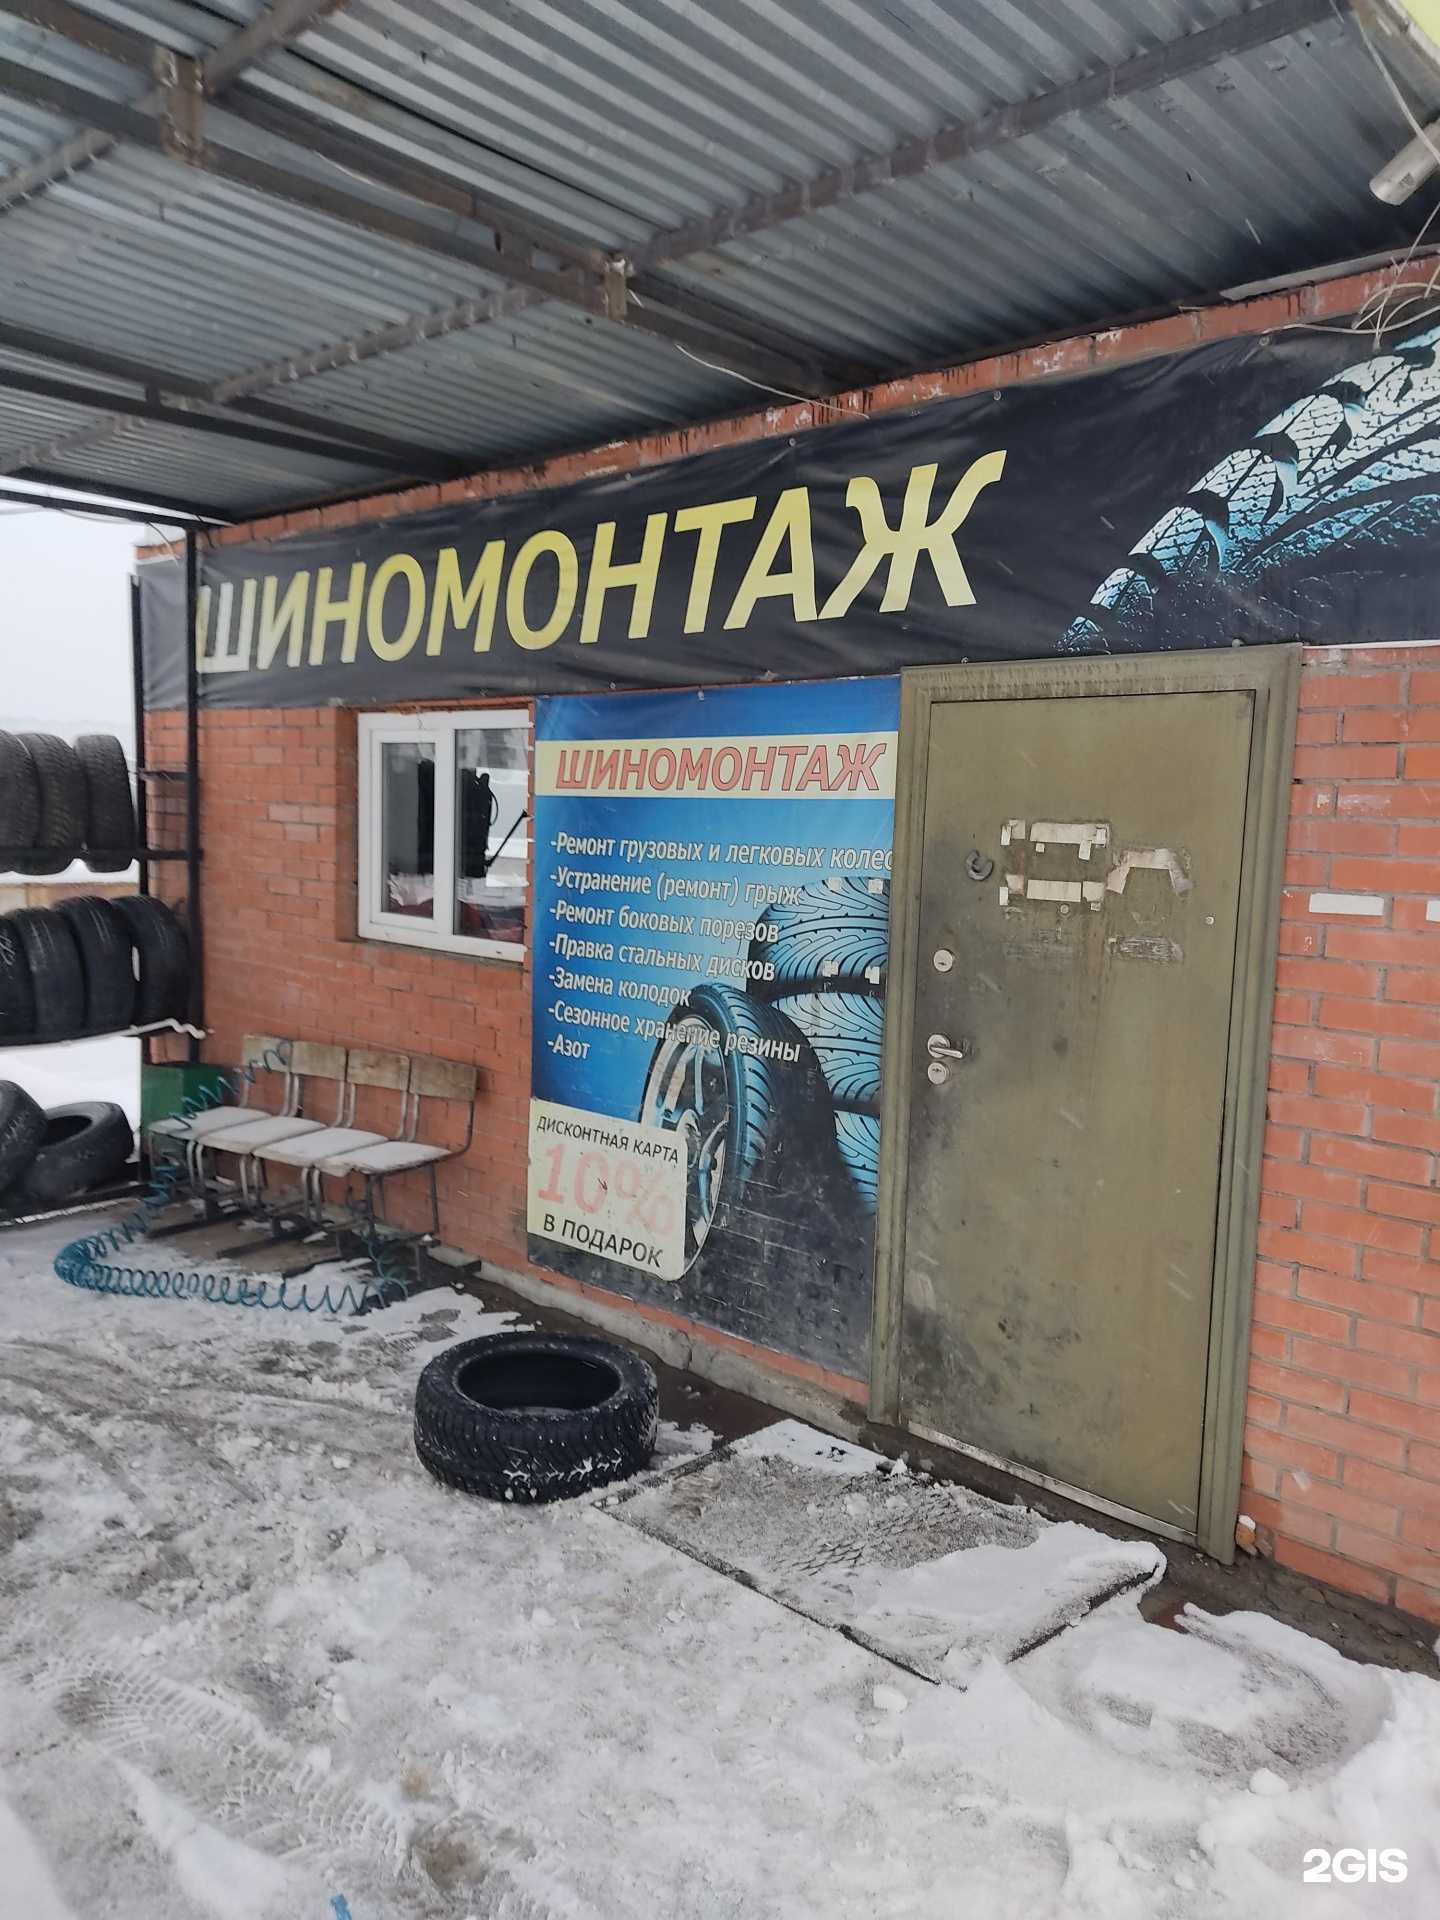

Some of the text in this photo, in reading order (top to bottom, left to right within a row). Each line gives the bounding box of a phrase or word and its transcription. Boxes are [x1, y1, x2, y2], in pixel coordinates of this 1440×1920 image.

[196, 450, 1007, 674] ШИНОМОНТАЖ
[555, 742, 887, 791] ШИНОМОНТАЖ
[550, 832, 616, 857] -Ремонт
[619, 839, 702, 863] грузовых
[708, 844, 720, 862] и
[725, 844, 825, 868] легковых
[550, 866, 802, 908] -Устранение (ремонт) грыж
[549, 900, 780, 943] -Ремонт боковых порезов
[549, 933, 776, 982] -Правка стальных дисков
[548, 966, 693, 1008] -Замена колодок
[547, 1035, 592, 1059] -Азот
[548, 1000, 801, 1063] -Сезонное хранение резины
[536, 1115, 679, 1164] ДИСКОНТНАЯ КАРТА
[538, 1143, 676, 1235] 10%
[543, 1213, 664, 1269] В ПОДАРОК
